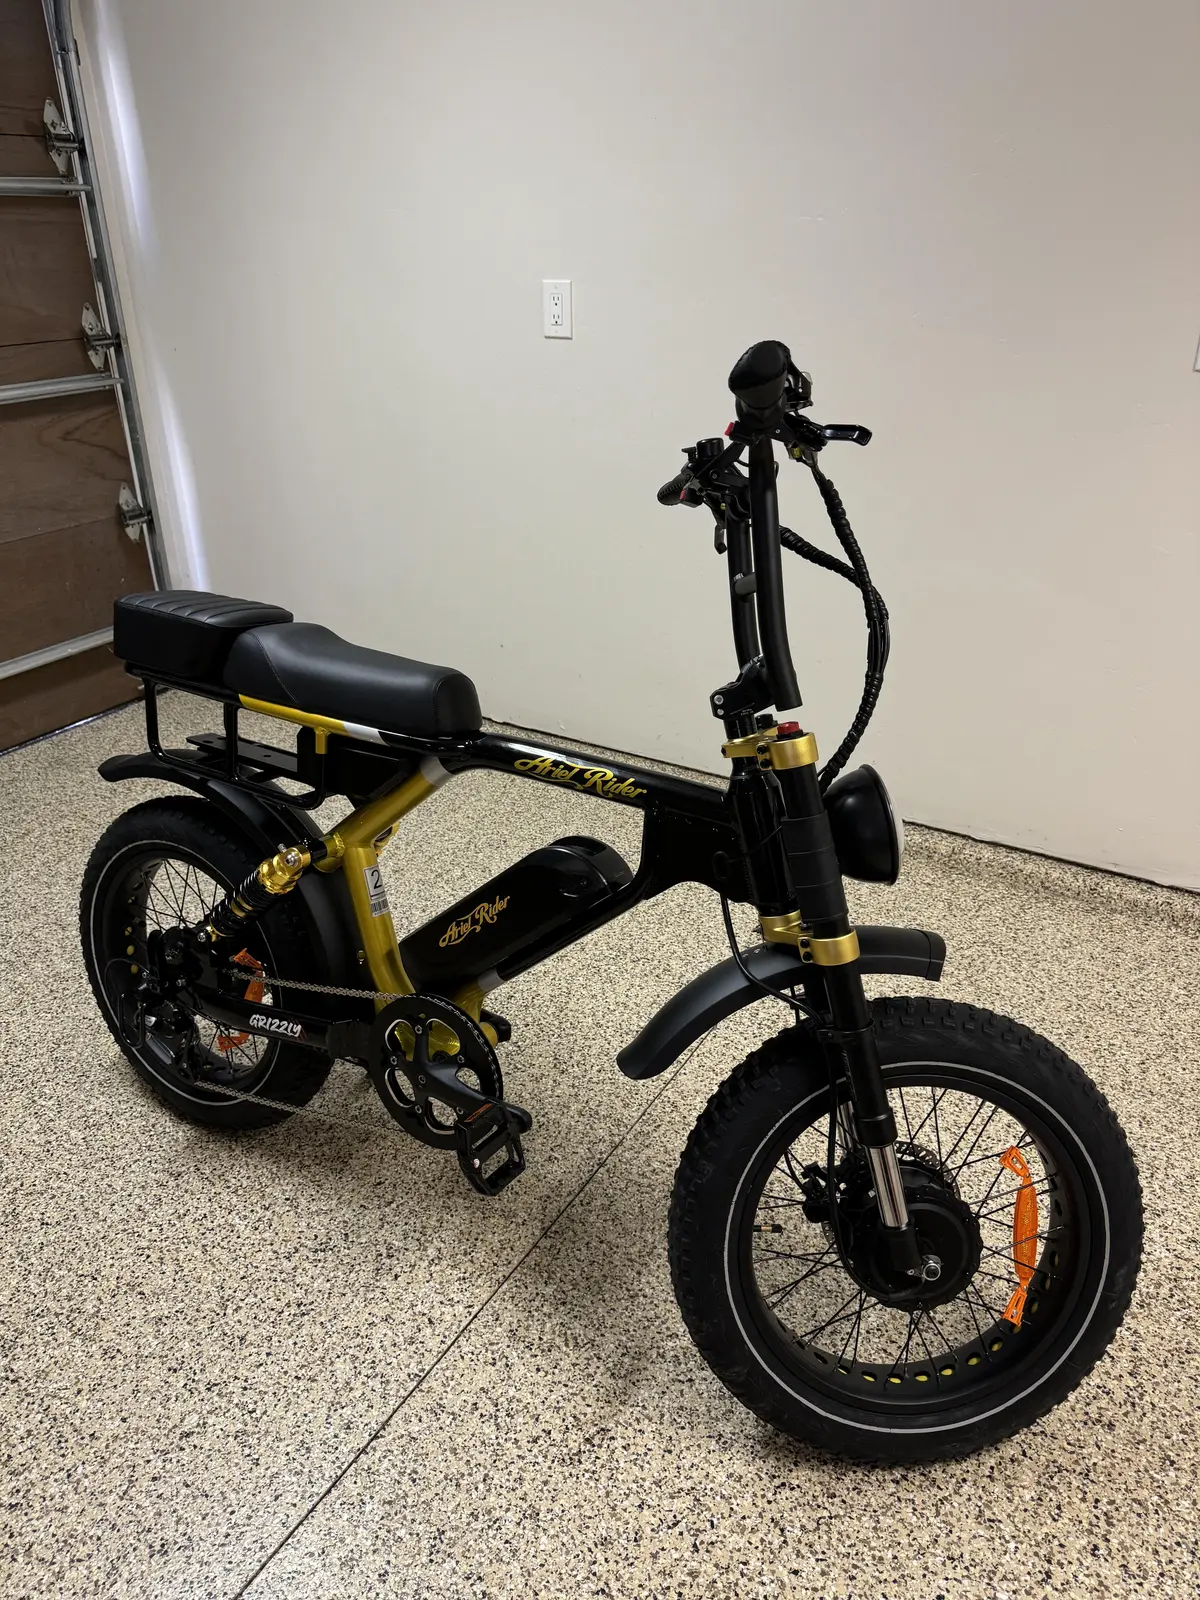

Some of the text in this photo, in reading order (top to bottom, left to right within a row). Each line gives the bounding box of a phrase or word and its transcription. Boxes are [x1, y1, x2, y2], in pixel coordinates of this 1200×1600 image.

[514, 756, 648, 799] Ariel Rider
[438, 895, 511, 948] Ariel Rider
[249, 1013, 302, 1038] GRIZZLY
